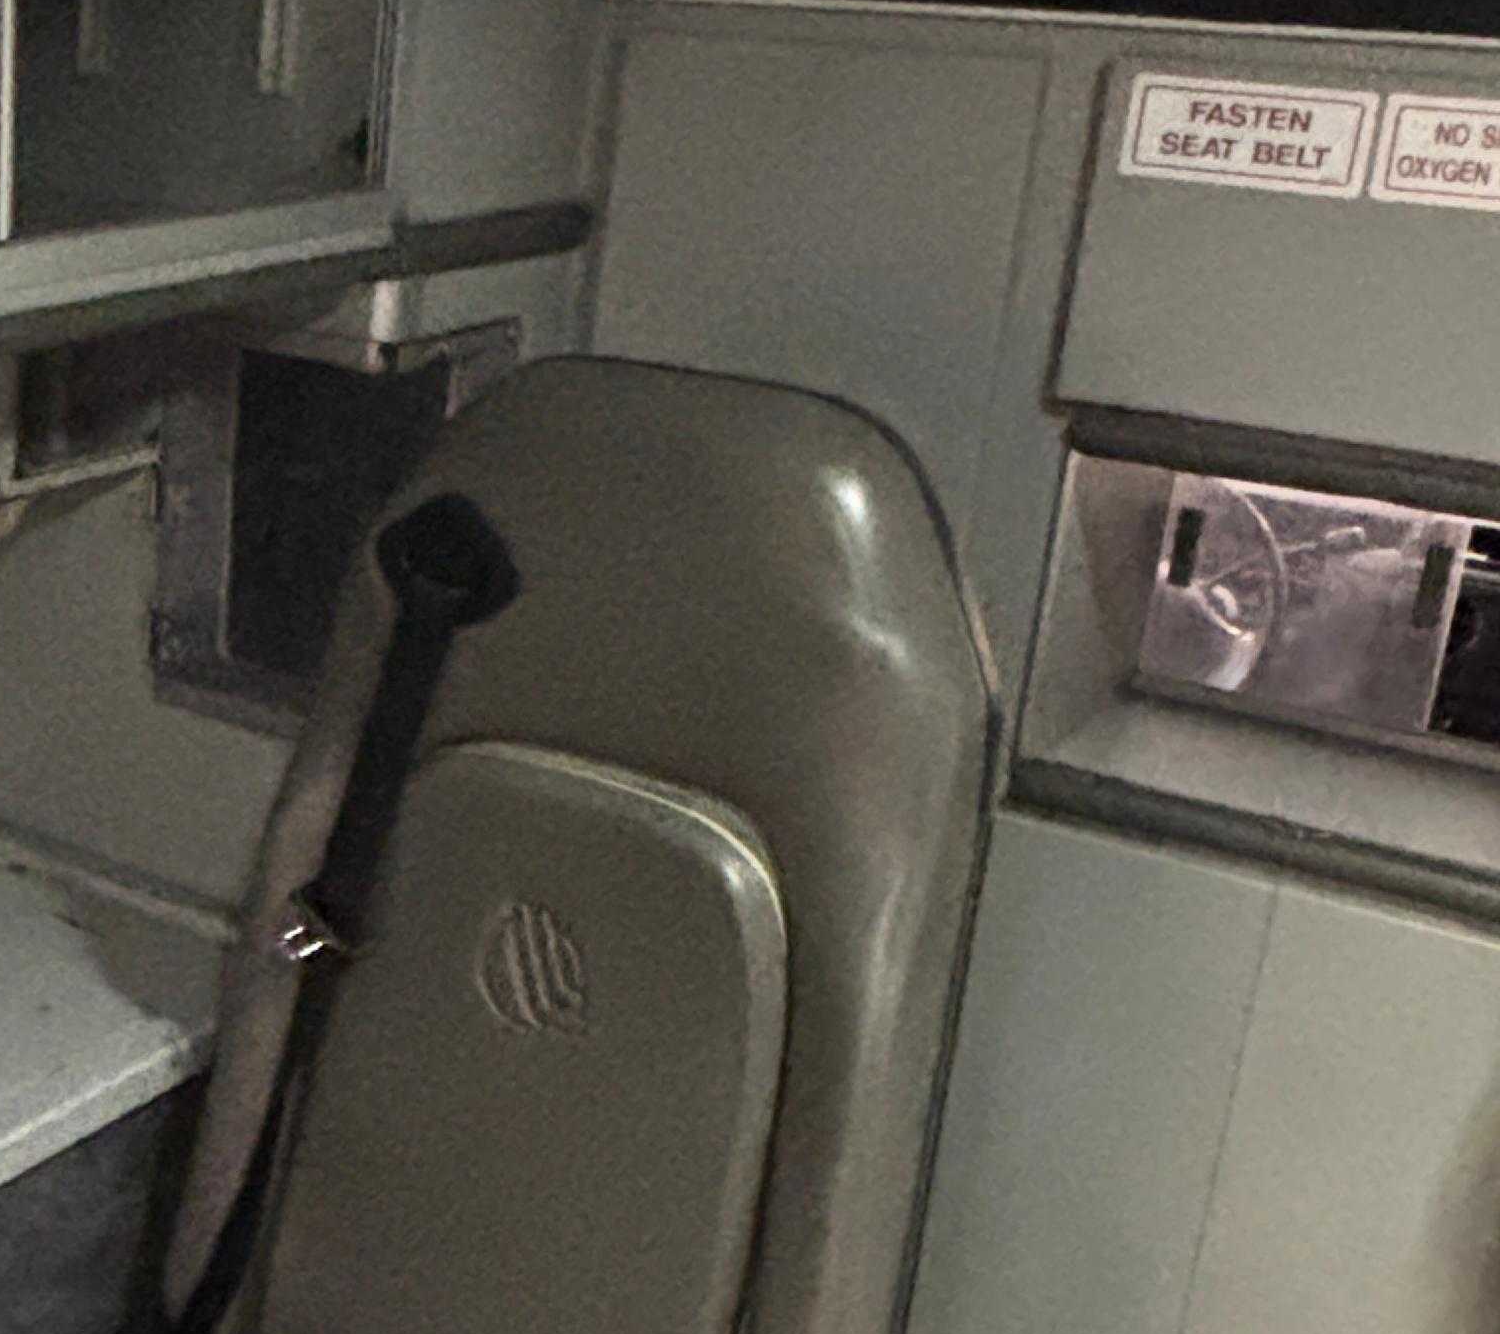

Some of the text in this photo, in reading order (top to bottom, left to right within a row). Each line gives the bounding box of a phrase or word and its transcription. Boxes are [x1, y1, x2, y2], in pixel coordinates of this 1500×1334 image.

[1188, 100, 1314, 133] FASTEN
[1159, 132, 1332, 170] SEAT BELT
[1434, 121, 1500, 150] NO S
[1395, 155, 1492, 186] OXYGEN
